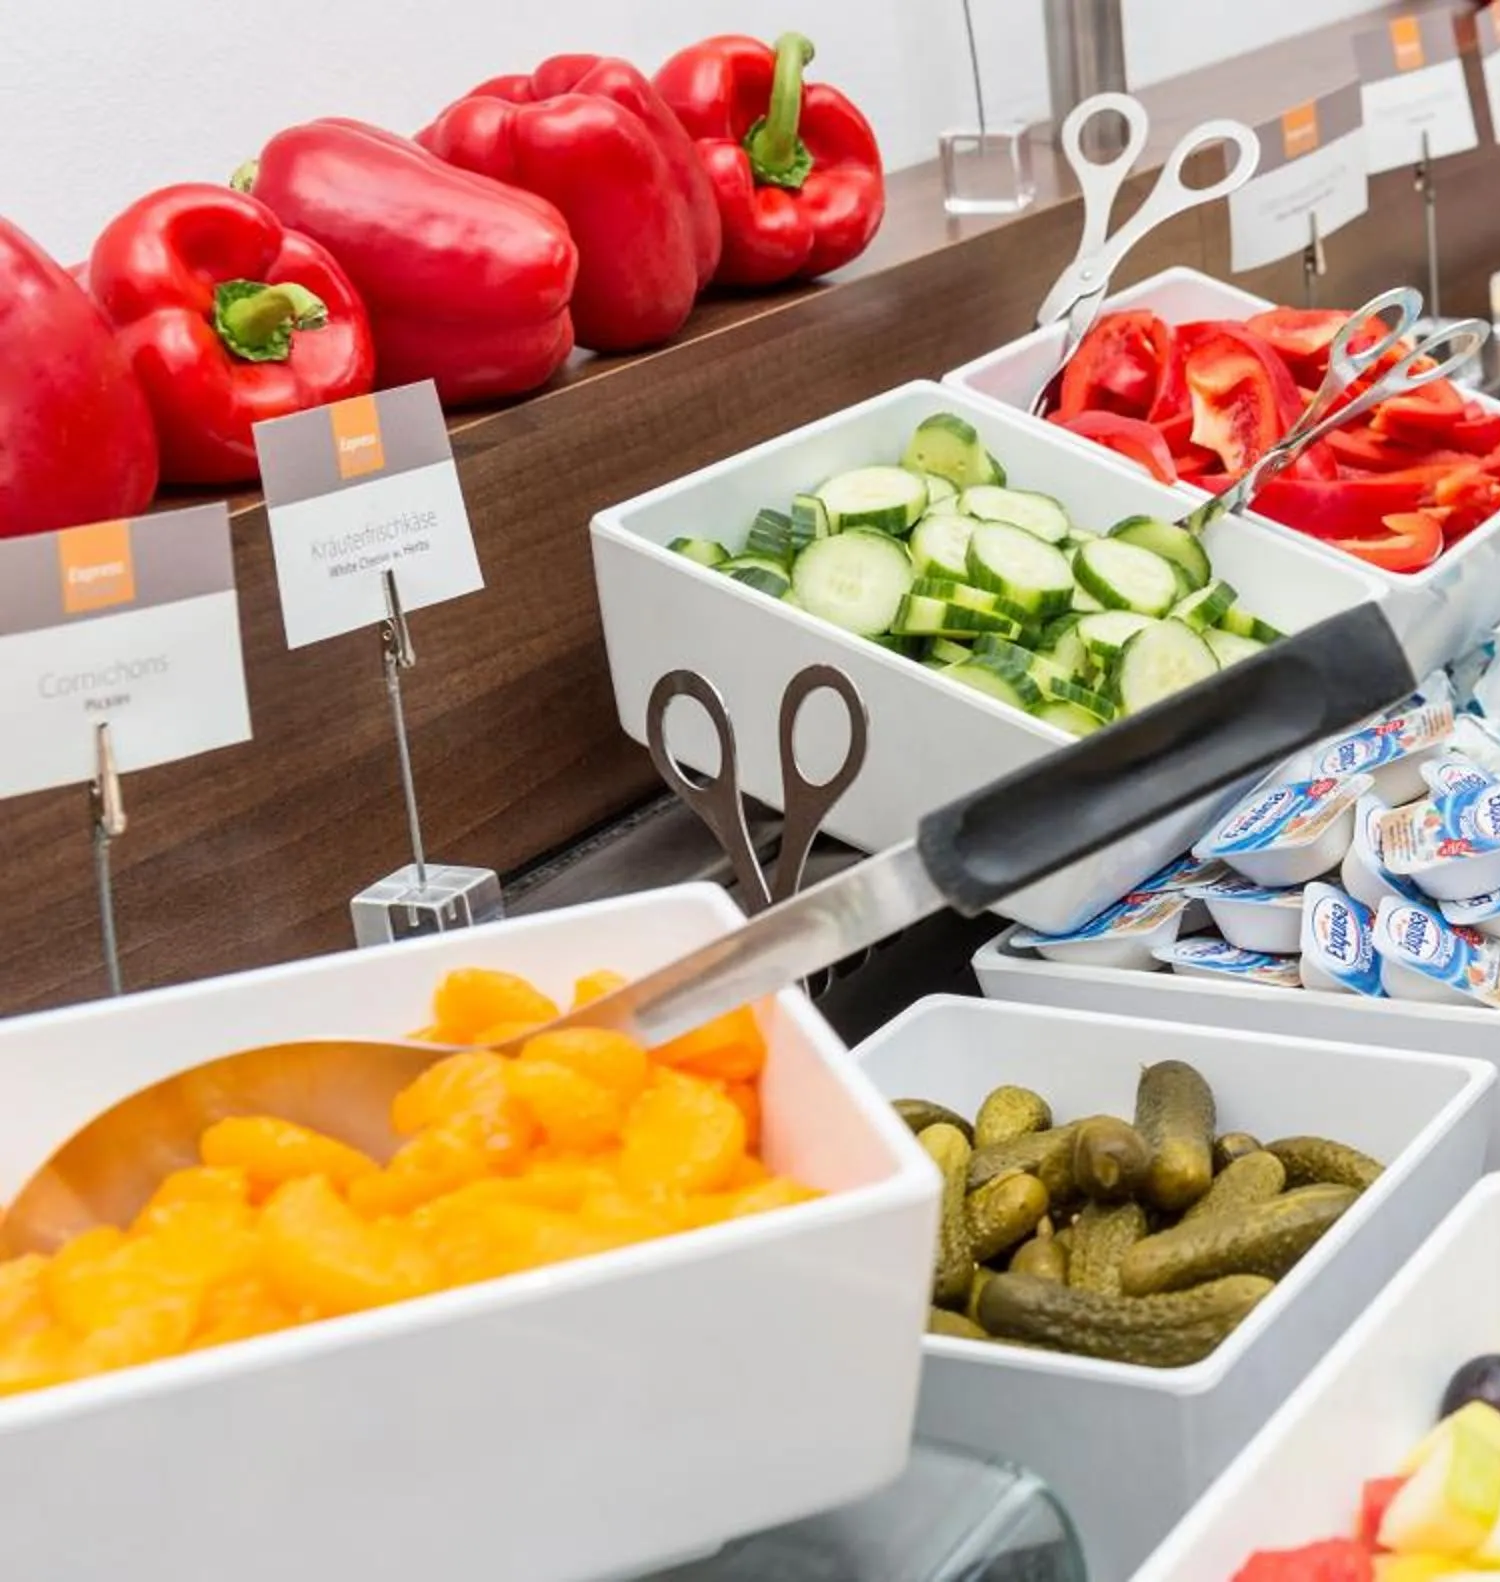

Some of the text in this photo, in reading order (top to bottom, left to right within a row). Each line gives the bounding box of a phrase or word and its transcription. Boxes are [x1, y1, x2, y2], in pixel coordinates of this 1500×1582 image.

[310, 511, 439, 562] Kräuterfrischkäse
[38, 653, 170, 699] Cornichons
[1325, 902, 1352, 961] Exquisa
[1400, 910, 1430, 957] Exquisa
